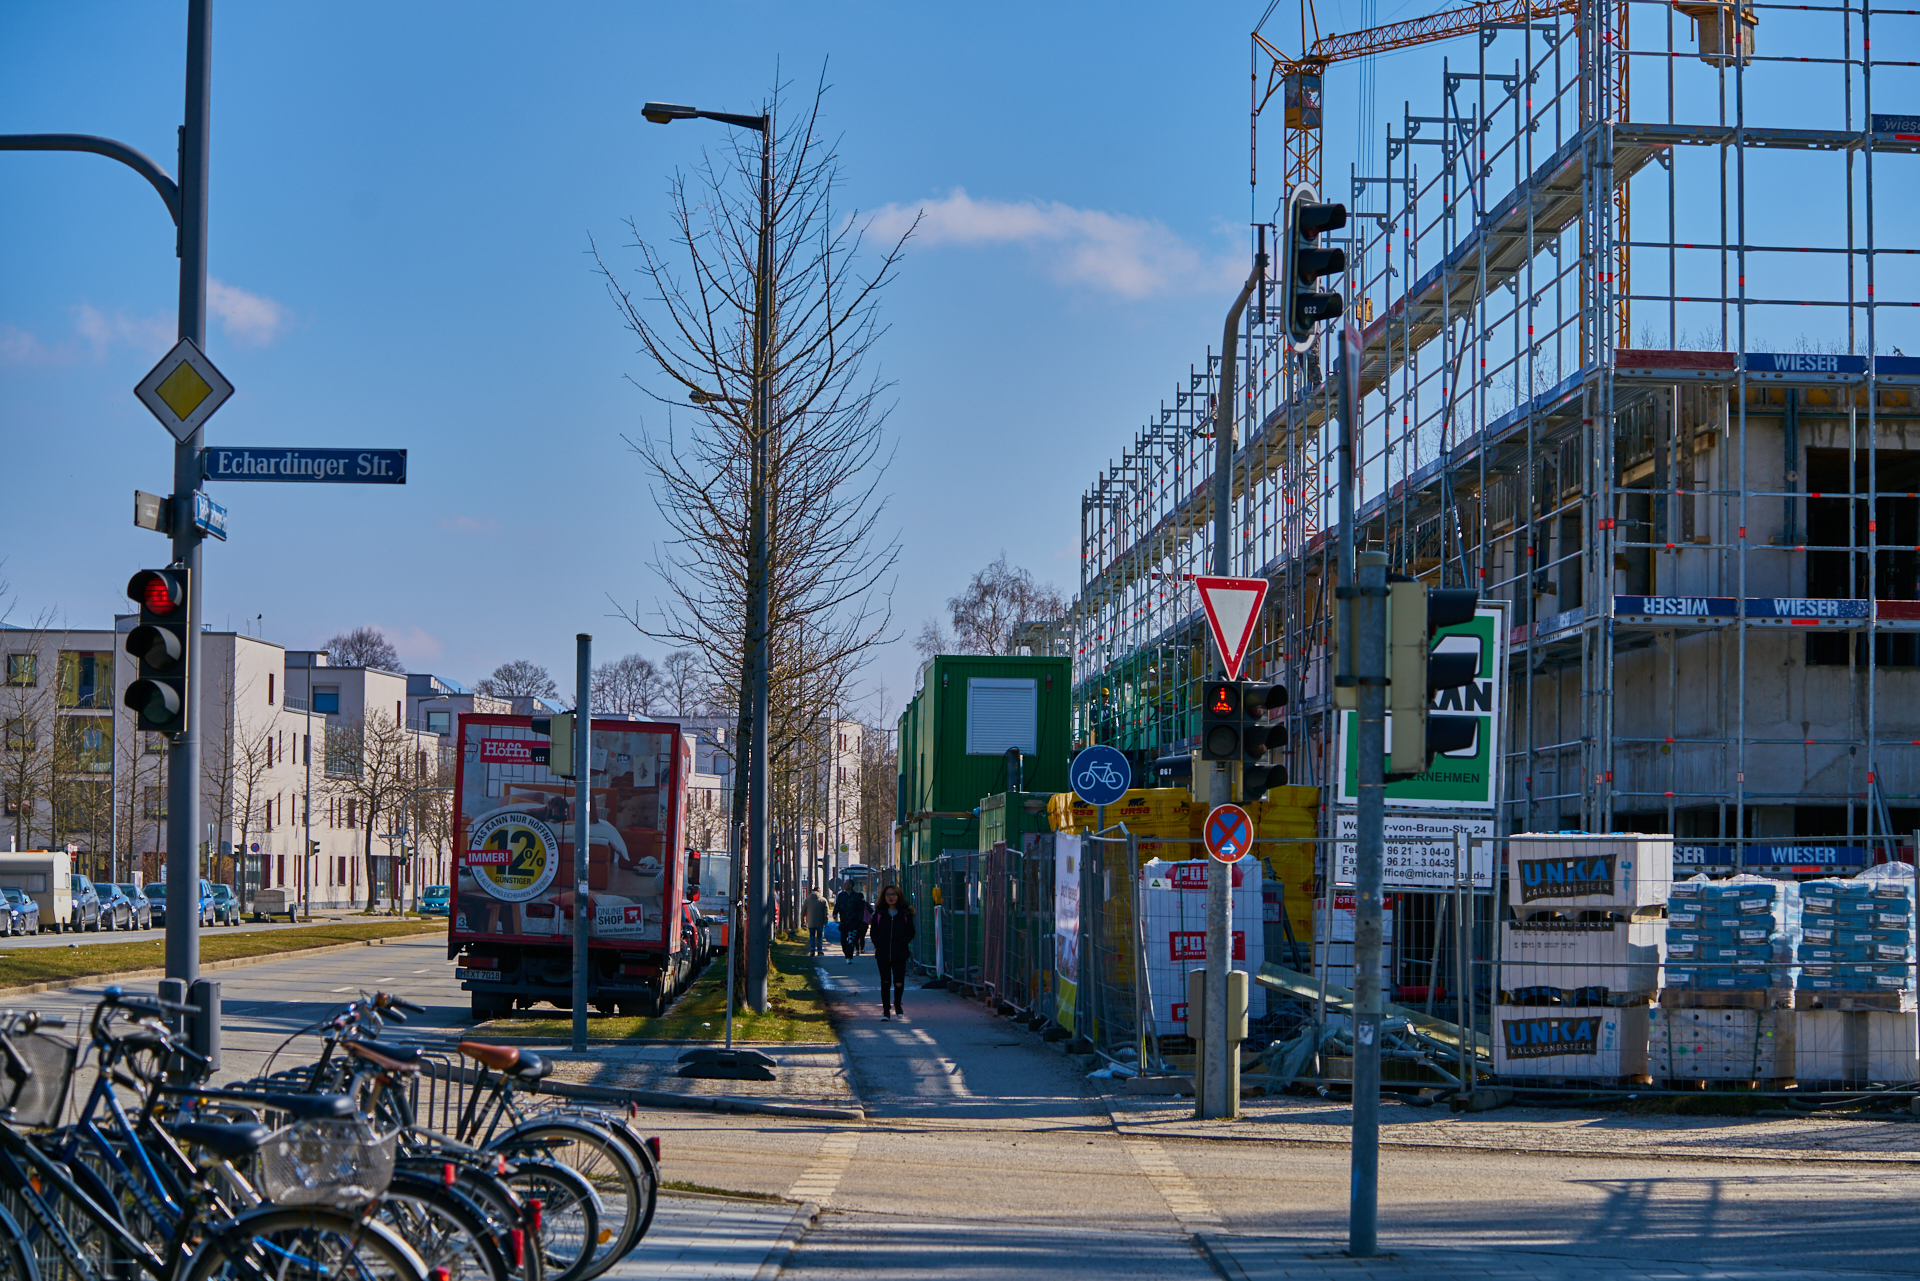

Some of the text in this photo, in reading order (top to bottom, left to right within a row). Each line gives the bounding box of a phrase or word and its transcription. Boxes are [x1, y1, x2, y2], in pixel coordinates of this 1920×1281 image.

[1885, 120, 1920, 131] wies
[1773, 354, 1838, 372] WIESER
[218, 451, 394, 480] Echardinger Str.
[1643, 597, 1710, 616] WIESER
[1773, 599, 1838, 617] WIESER
[484, 742, 533, 758] Höffn
[474, 815, 556, 851] DAS KANN NUR HÖFFNER!
[1474, 825, 1487, 834] 24
[468, 853, 508, 862] IMMER!
[1387, 847, 1398, 855] 96
[1401, 847, 1412, 855] 21
[1421, 847, 1427, 856] 3
[1429, 848, 1450, 857] 04-0
[1673, 846, 1705, 863] SER
[1771, 846, 1836, 864] WIESER
[1386, 857, 1398, 866] 96
[1400, 858, 1412, 866] 21
[1421, 858, 1427, 867] 3
[495, 875, 532, 885] GÜNSTIGER
[597, 906, 623, 916] ONLINE
[598, 915, 623, 925] SHOP
[481, 971, 500, 980] 7018
[1511, 1042, 1592, 1055] KALKSANDSTEIN
